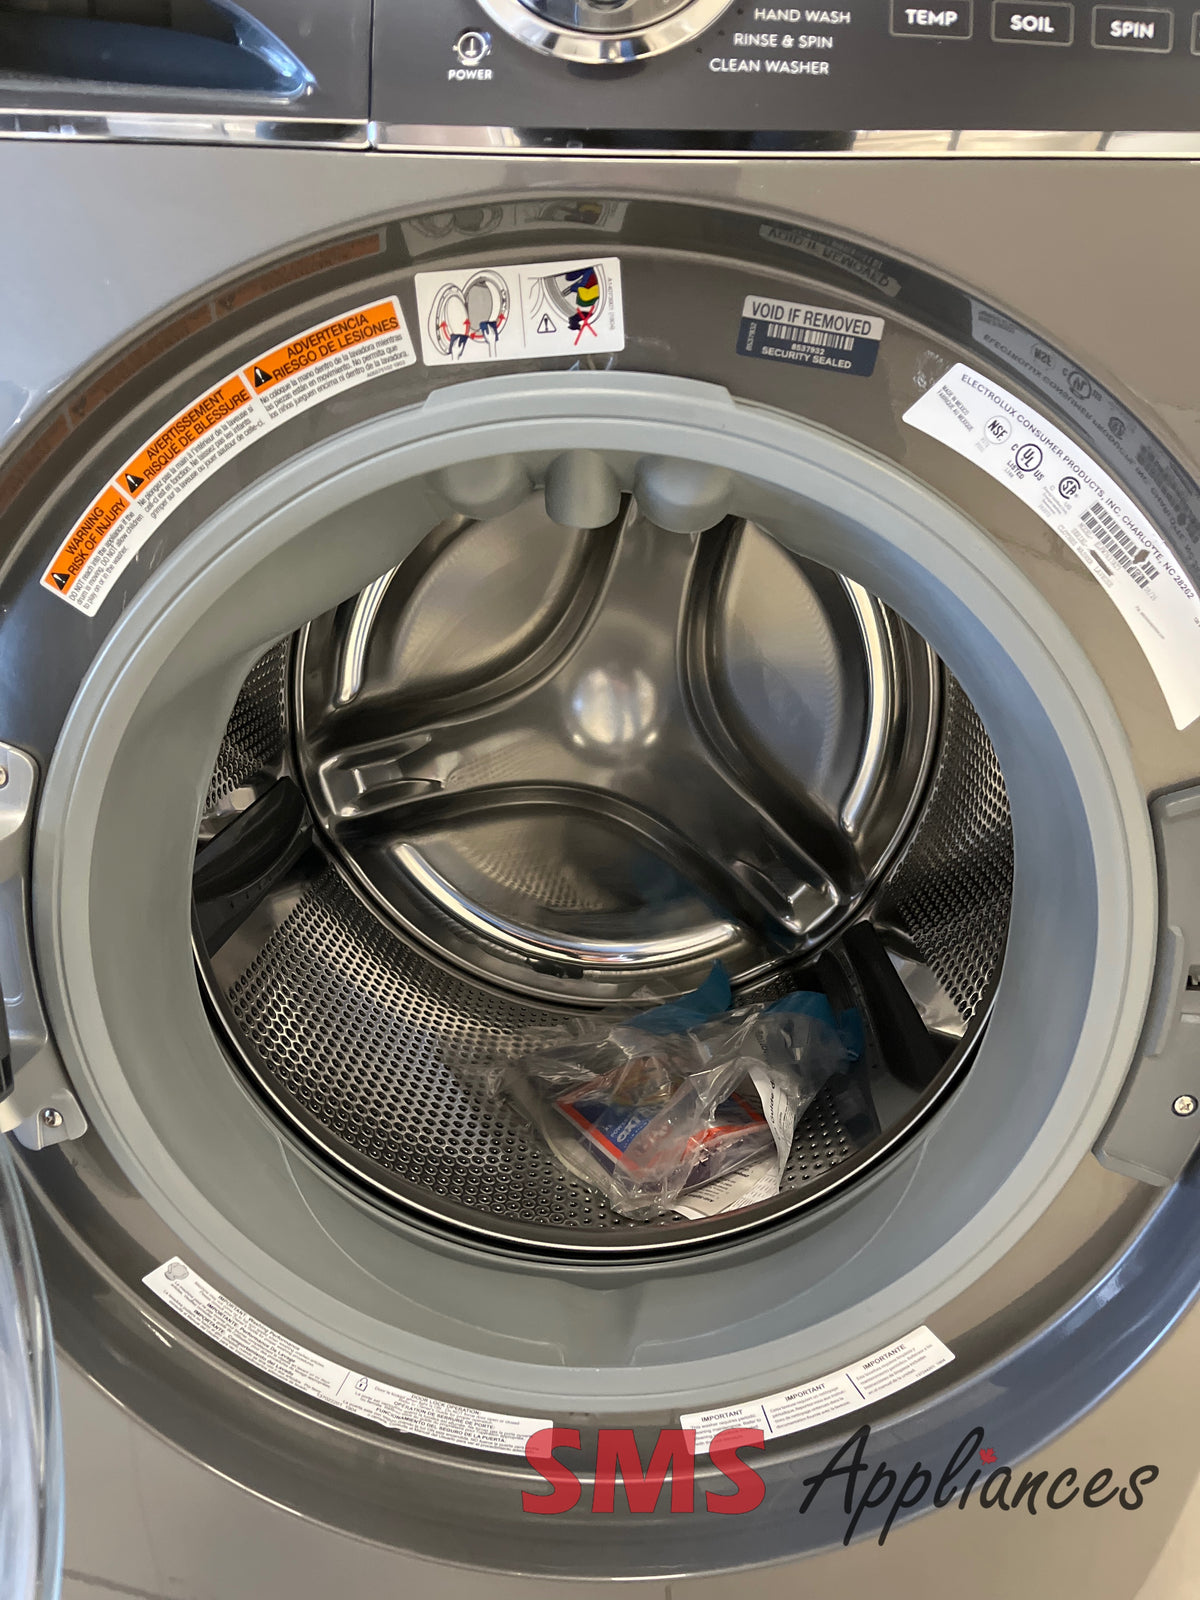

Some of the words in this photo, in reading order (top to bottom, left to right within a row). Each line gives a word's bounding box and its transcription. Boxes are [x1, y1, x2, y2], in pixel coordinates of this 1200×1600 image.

[753, 8, 801, 21] HAND
[805, 9, 851, 25] WASH
[904, 8, 958, 27] TEMP
[1010, 14, 1055, 33] SOIL
[1109, 20, 1155, 39] SPIN
[734, 32, 779, 48] RINSE
[782, 35, 794, 49] &
[798, 34, 834, 49] SPIN
[447, 69, 493, 81] POWER
[709, 58, 761, 73] CLEAN
[764, 60, 830, 75] WASHER
[752, 301, 784, 320] VOID
[787, 307, 801, 322] IF
[803, 311, 871, 335] REMOVED
[287, 314, 368, 358] ADVERTENCIA
[272, 350, 316, 380] RIESGO
[318, 340, 336, 356] DE
[337, 316, 398, 348] LESIONES
[351, 358, 361, 366] No
[385, 345, 397, 353] que
[762, 346, 810, 360] SECURITY
[812, 355, 851, 368] SEALED
[268, 383, 291, 398] coloque
[297, 370, 314, 382] mano
[314, 361, 333, 373] dentro
[348, 343, 374, 358] lavadora
[345, 366, 364, 378] dentro
[147, 389, 223, 459] AVERTISSEMENT
[177, 429, 195, 447] DE
[193, 389, 249, 434] BLESSURE
[236, 433, 244, 441] de
[987, 419, 1007, 438] NSF
[1010, 443, 1018, 451] C
[137, 498, 146, 506] Ne
[161, 472, 171, 483] pas
[214, 428, 222, 436] de
[1006, 460, 1024, 479] LISTED
[1033, 469, 1044, 480] US
[164, 483, 172, 491] en
[961, 374, 1016, 416] ELECTROLUX
[1016, 414, 1063, 457] CONSUMER
[1062, 455, 1104, 497] PRODUCTS,
[1122, 515, 1162, 563] CHARLOTTE,
[1163, 561, 1175, 575] NC
[1173, 575, 1193, 598] 28262
[65, 506, 103, 554] WARNING
[67, 549, 88, 575] RISK
[84, 533, 96, 550] OF
[95, 498, 125, 535] INJURY
[68, 590, 77, 601] DO
[73, 579, 84, 592] NOT
[81, 565, 94, 580] reach
[97, 547, 106, 556] the
[124, 511, 134, 521] the
[76, 590, 88, 605] drum
[100, 556, 109, 566] DO
[106, 544, 117, 558] NOT
[125, 513, 143, 534] children
[86, 591, 97, 604] play
[93, 584, 101, 592] on
[105, 564, 114, 573] the
[862, 1344, 903, 1369] IMPORTANTE
[784, 1383, 824, 1401] IMPORTANT
[701, 1409, 742, 1421] IMPORTANT
